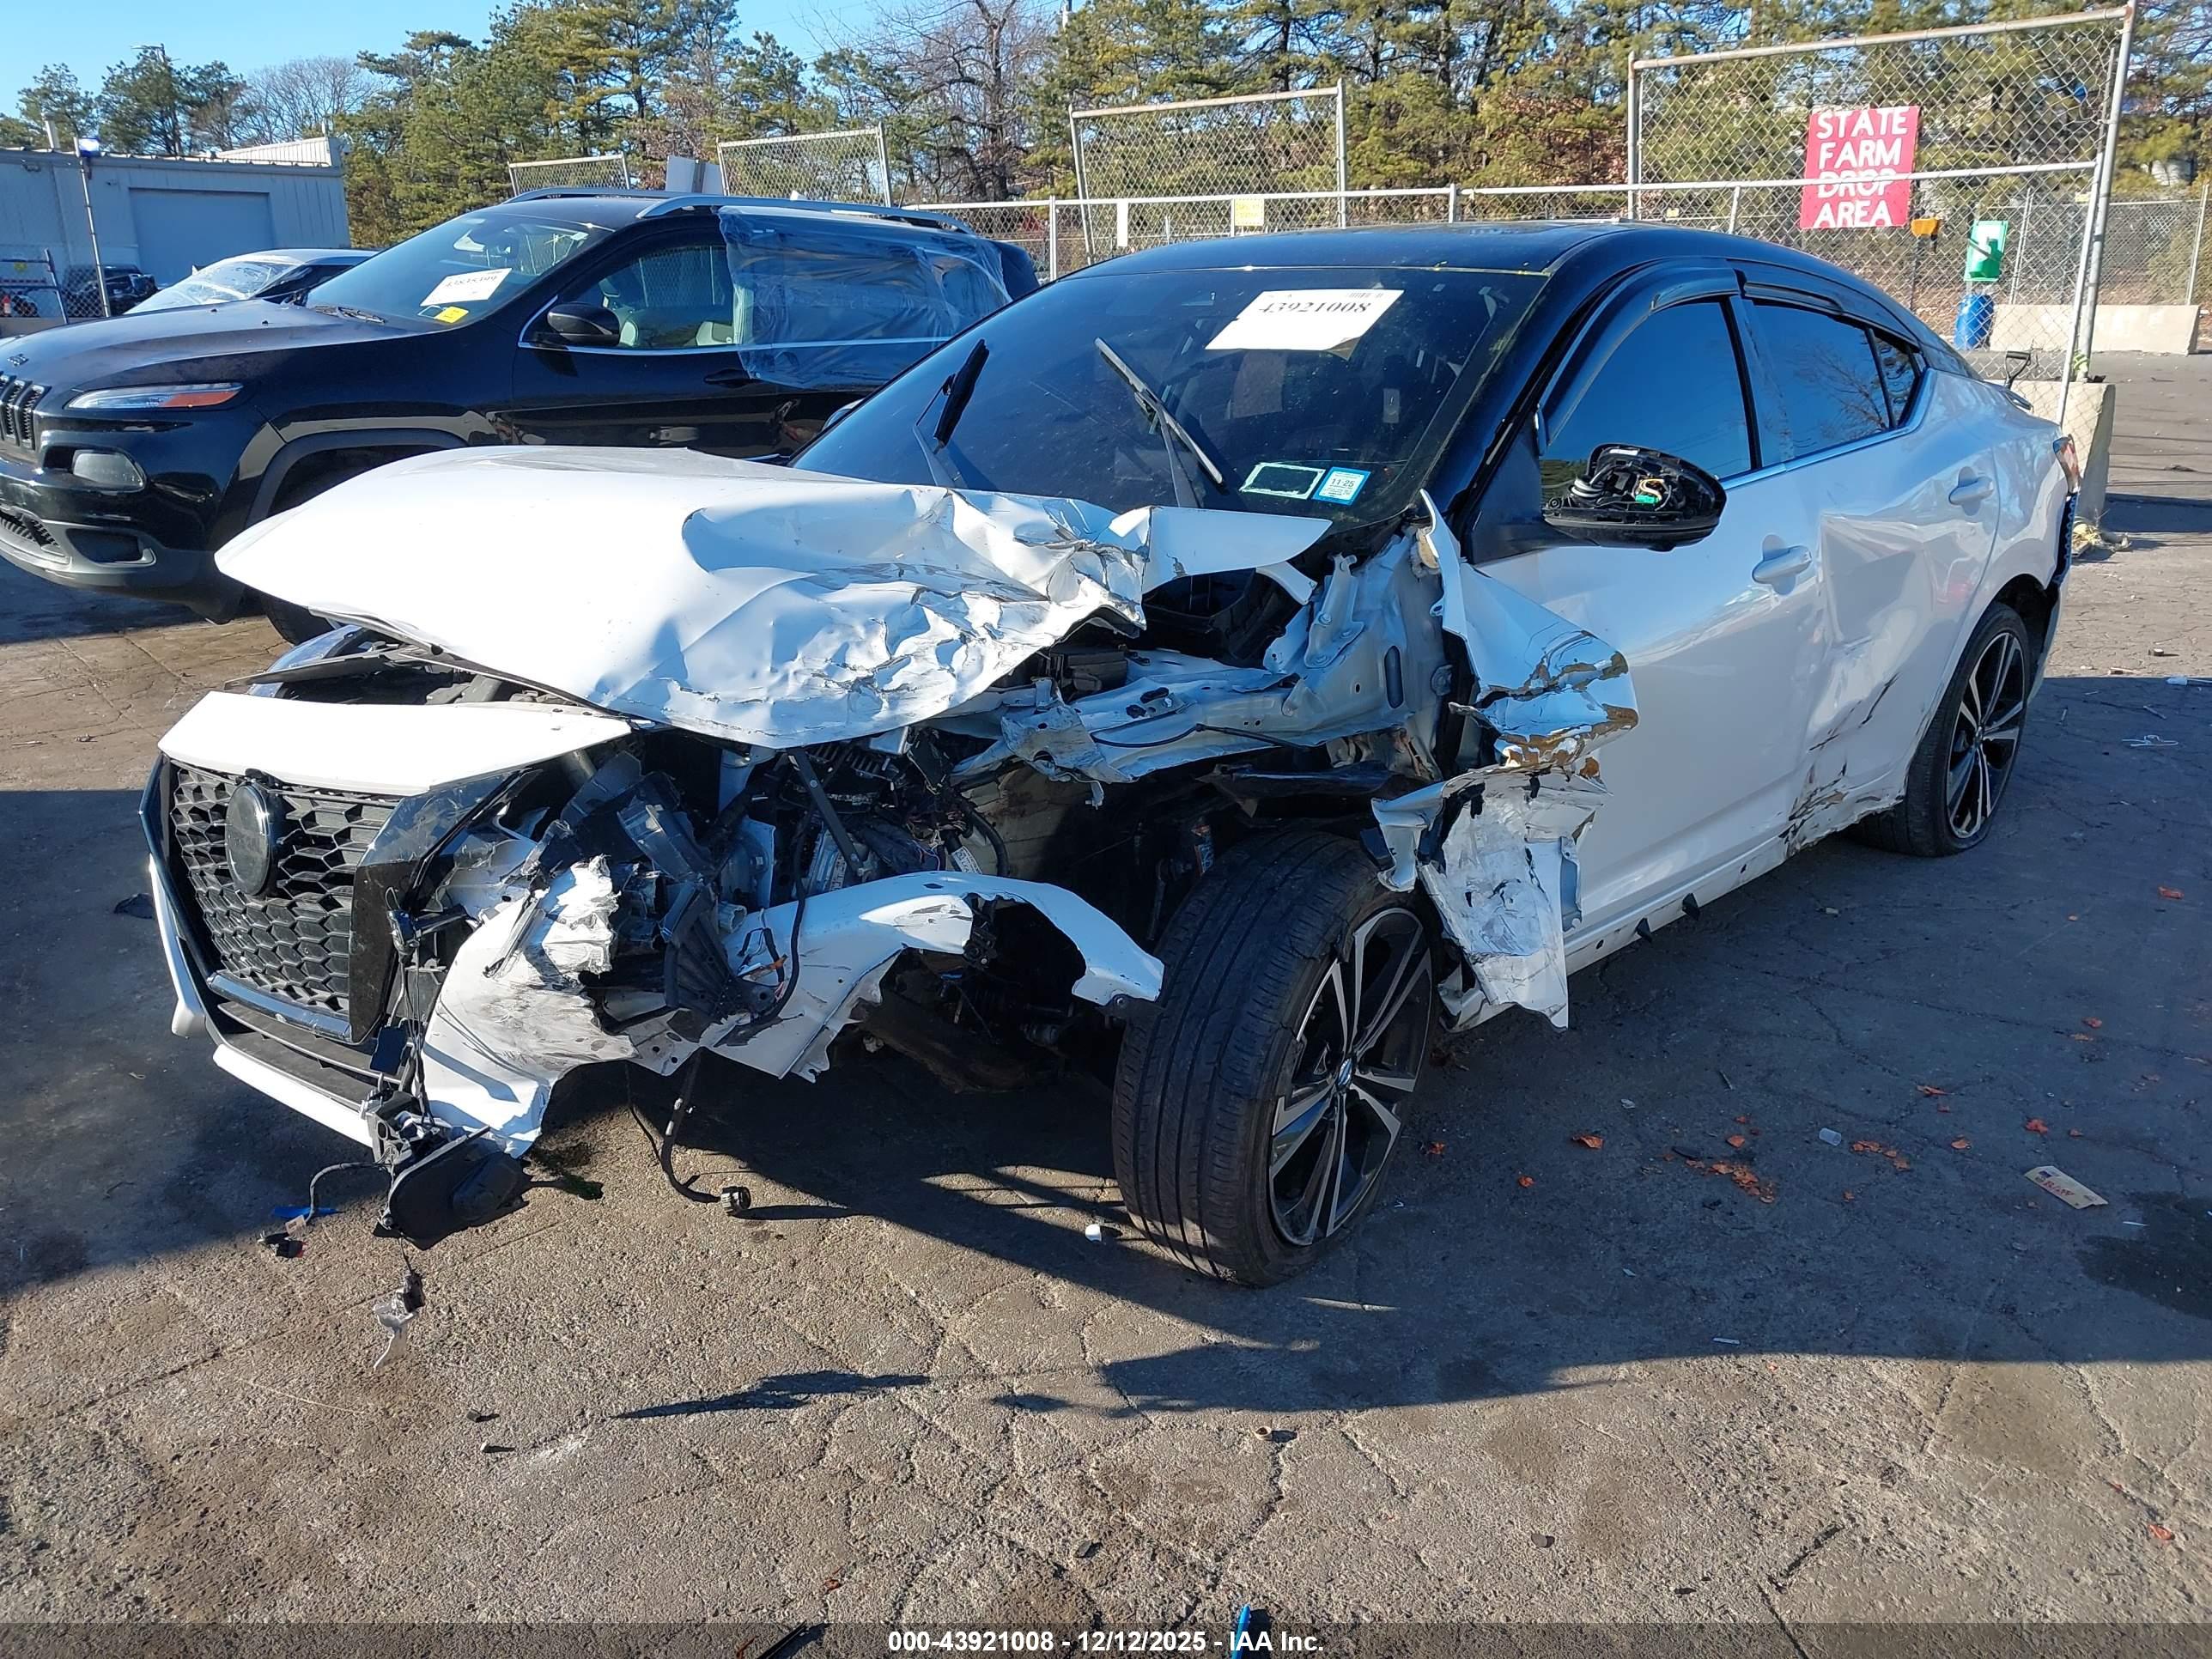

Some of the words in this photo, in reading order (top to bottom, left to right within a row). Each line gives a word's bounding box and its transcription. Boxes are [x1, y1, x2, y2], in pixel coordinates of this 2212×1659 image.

[1816, 106, 1910, 138] STATE
[1819, 137, 1903, 170] FARM
[1818, 167, 1897, 198] DROP
[1813, 199, 1893, 228] AREA
[1258, 301, 1371, 313] 43921008
